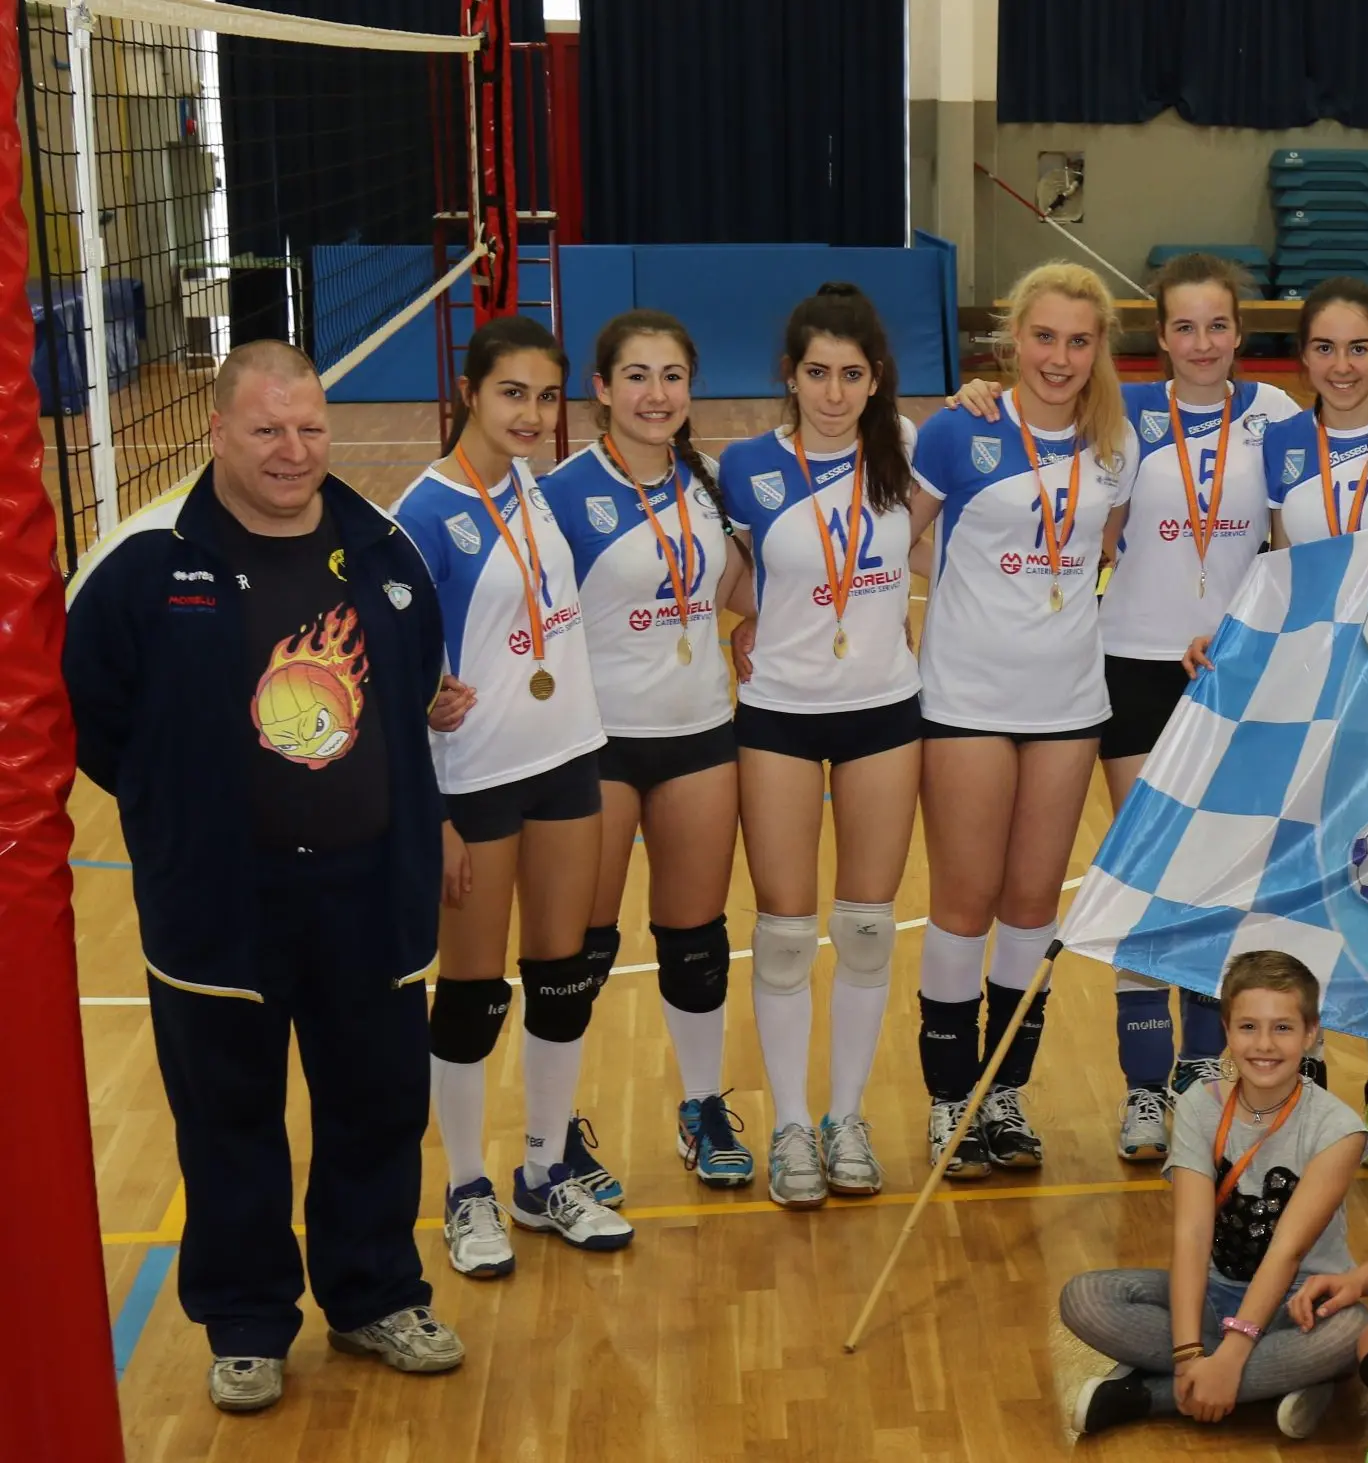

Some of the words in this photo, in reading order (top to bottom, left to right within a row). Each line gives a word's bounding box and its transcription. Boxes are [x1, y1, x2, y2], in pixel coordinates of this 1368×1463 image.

[827, 504, 883, 570] 12
[1026, 555, 1085, 568] MOELLI
[541, 602, 580, 632] ORELLI
[1126, 1018, 1171, 1031] molten
